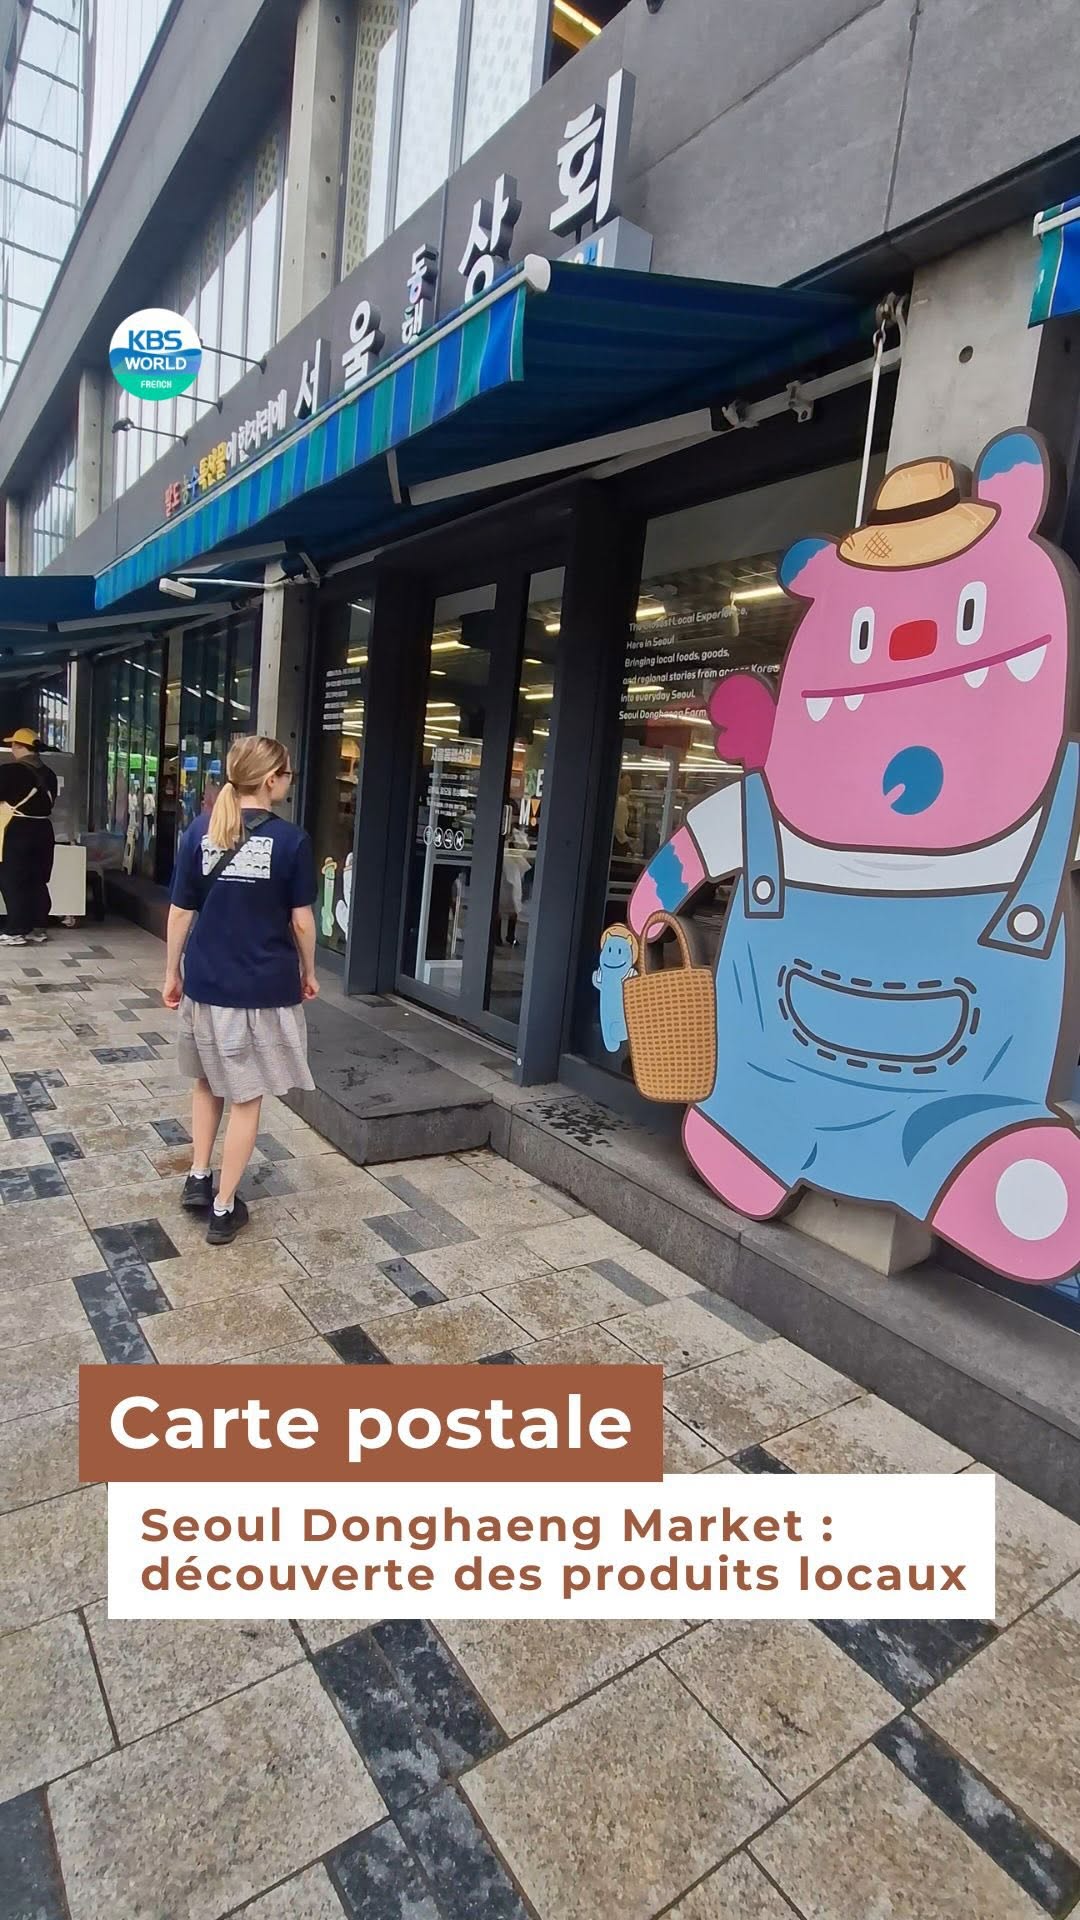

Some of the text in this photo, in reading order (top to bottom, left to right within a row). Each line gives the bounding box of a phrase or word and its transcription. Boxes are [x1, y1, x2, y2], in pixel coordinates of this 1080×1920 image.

[238, 389, 287, 463] 한자리에
[672, 612, 695, 626] Local
[626, 634, 675, 649] Here in Seoul
[624, 647, 730, 668] Bringing local foods, goods,
[622, 674, 636, 685] and
[637, 672, 668, 685] regional
[669, 670, 696, 681] stories
[697, 668, 718, 679] from
[635, 690, 671, 702] everyday
[619, 710, 639, 720] Seoul
